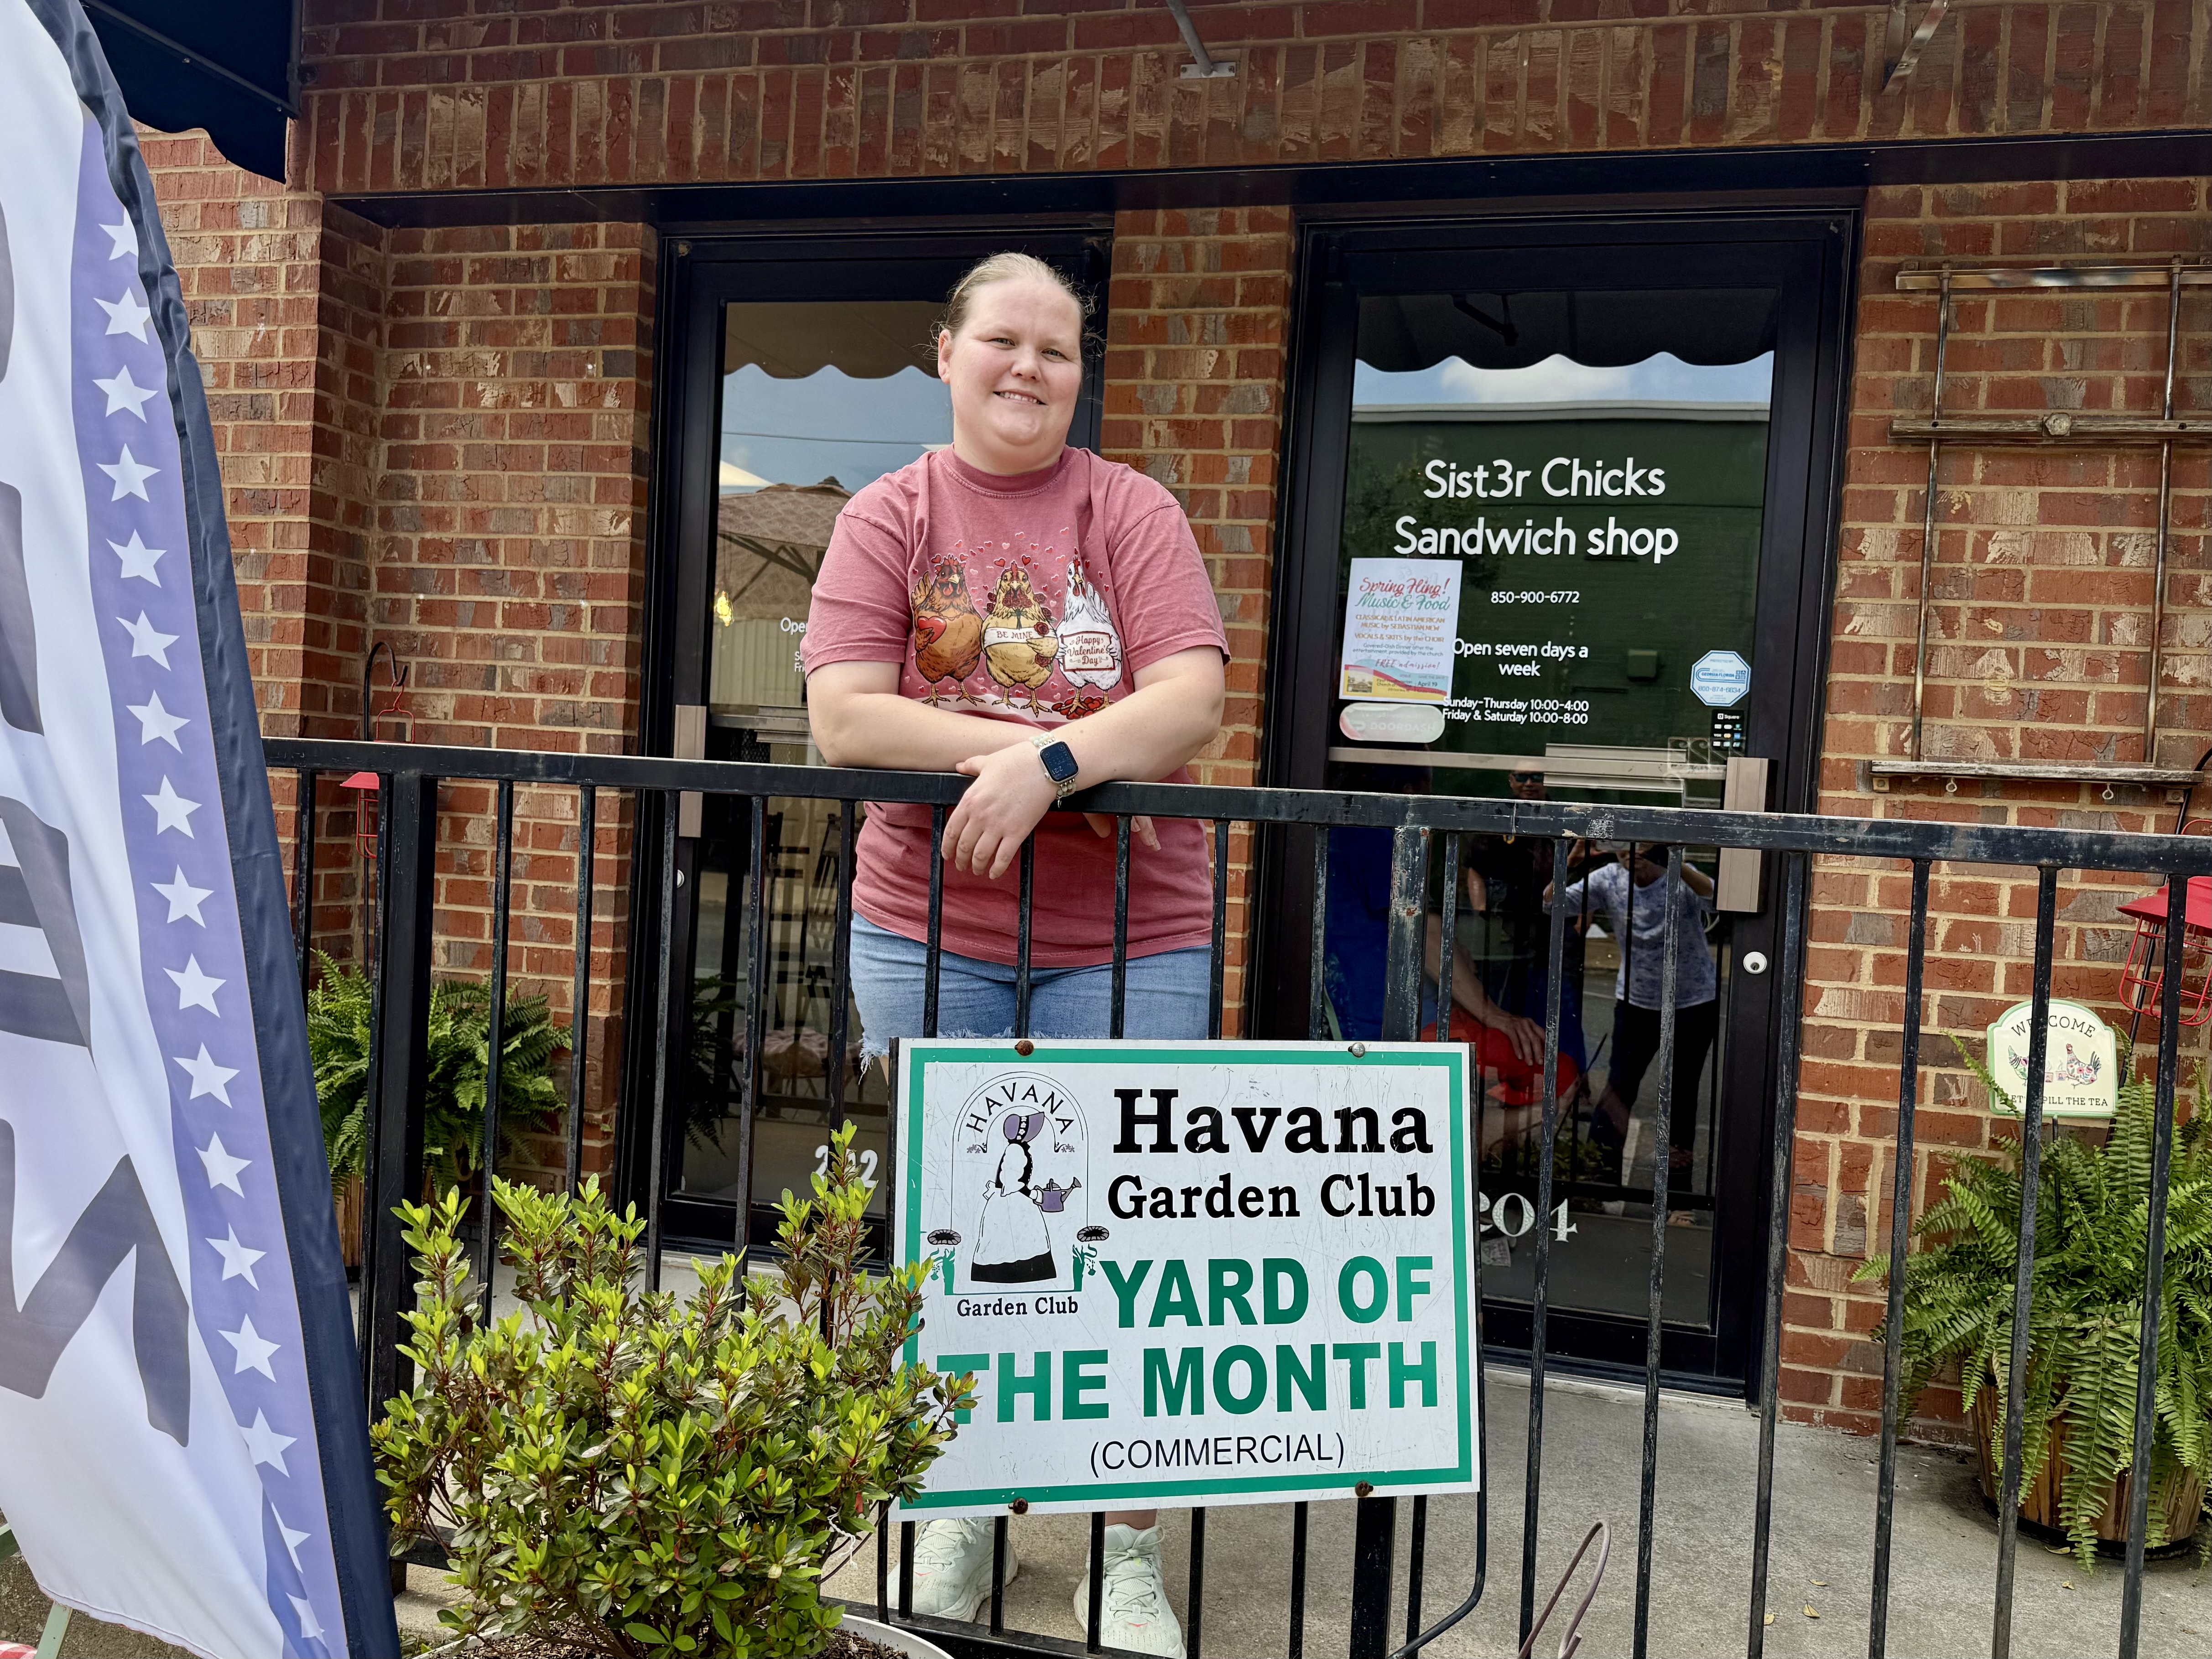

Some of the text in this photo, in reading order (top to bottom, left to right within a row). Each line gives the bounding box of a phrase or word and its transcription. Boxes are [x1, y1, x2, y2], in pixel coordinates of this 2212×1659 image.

[1423, 457, 1666, 499] Sist3r Chicks
[1393, 515, 1679, 564] Sandwich shop
[1359, 577, 1451, 599] Spring Fling!
[1355, 593, 1451, 611] Music & Food
[1491, 591, 1580, 603] 850-900-6772
[1355, 614, 1387, 622] CLASSICAL
[1381, 622, 1390, 631] by
[1011, 631, 1033, 640] MINE
[1075, 634, 1101, 645] Happy
[1067, 645, 1109, 656] Valentine's
[1452, 638, 1589, 661] Open seven days a
[1082, 655, 1099, 666] Day
[1374, 658, 1441, 670] FREE admission!
[1498, 660, 1541, 676] week
[1443, 697, 1589, 712] Sunday-Thursday 10:00-4:00
[1442, 708, 1589, 725] Friday & Saturday 10:00-8:00
[1370, 722, 1435, 731] DOORDASH
[2011, 1015, 2096, 1038] WCOME
[965, 1082, 1075, 1135] HAVANA
[2042, 1097, 2064, 1105] PILL
[2066, 1097, 2086, 1105] THE
[2088, 1098, 2108, 1107] TEA
[1113, 1089, 1434, 1154] Havana
[1108, 1172, 1436, 1219] Garden Club
[1099, 1255, 1433, 1328] YARD OF
[957, 1295, 1078, 1317] Garden Club
[937, 1340, 1438, 1425] THE MONTH
[1090, 1432, 1345, 1478] (COMMERCIAL)
